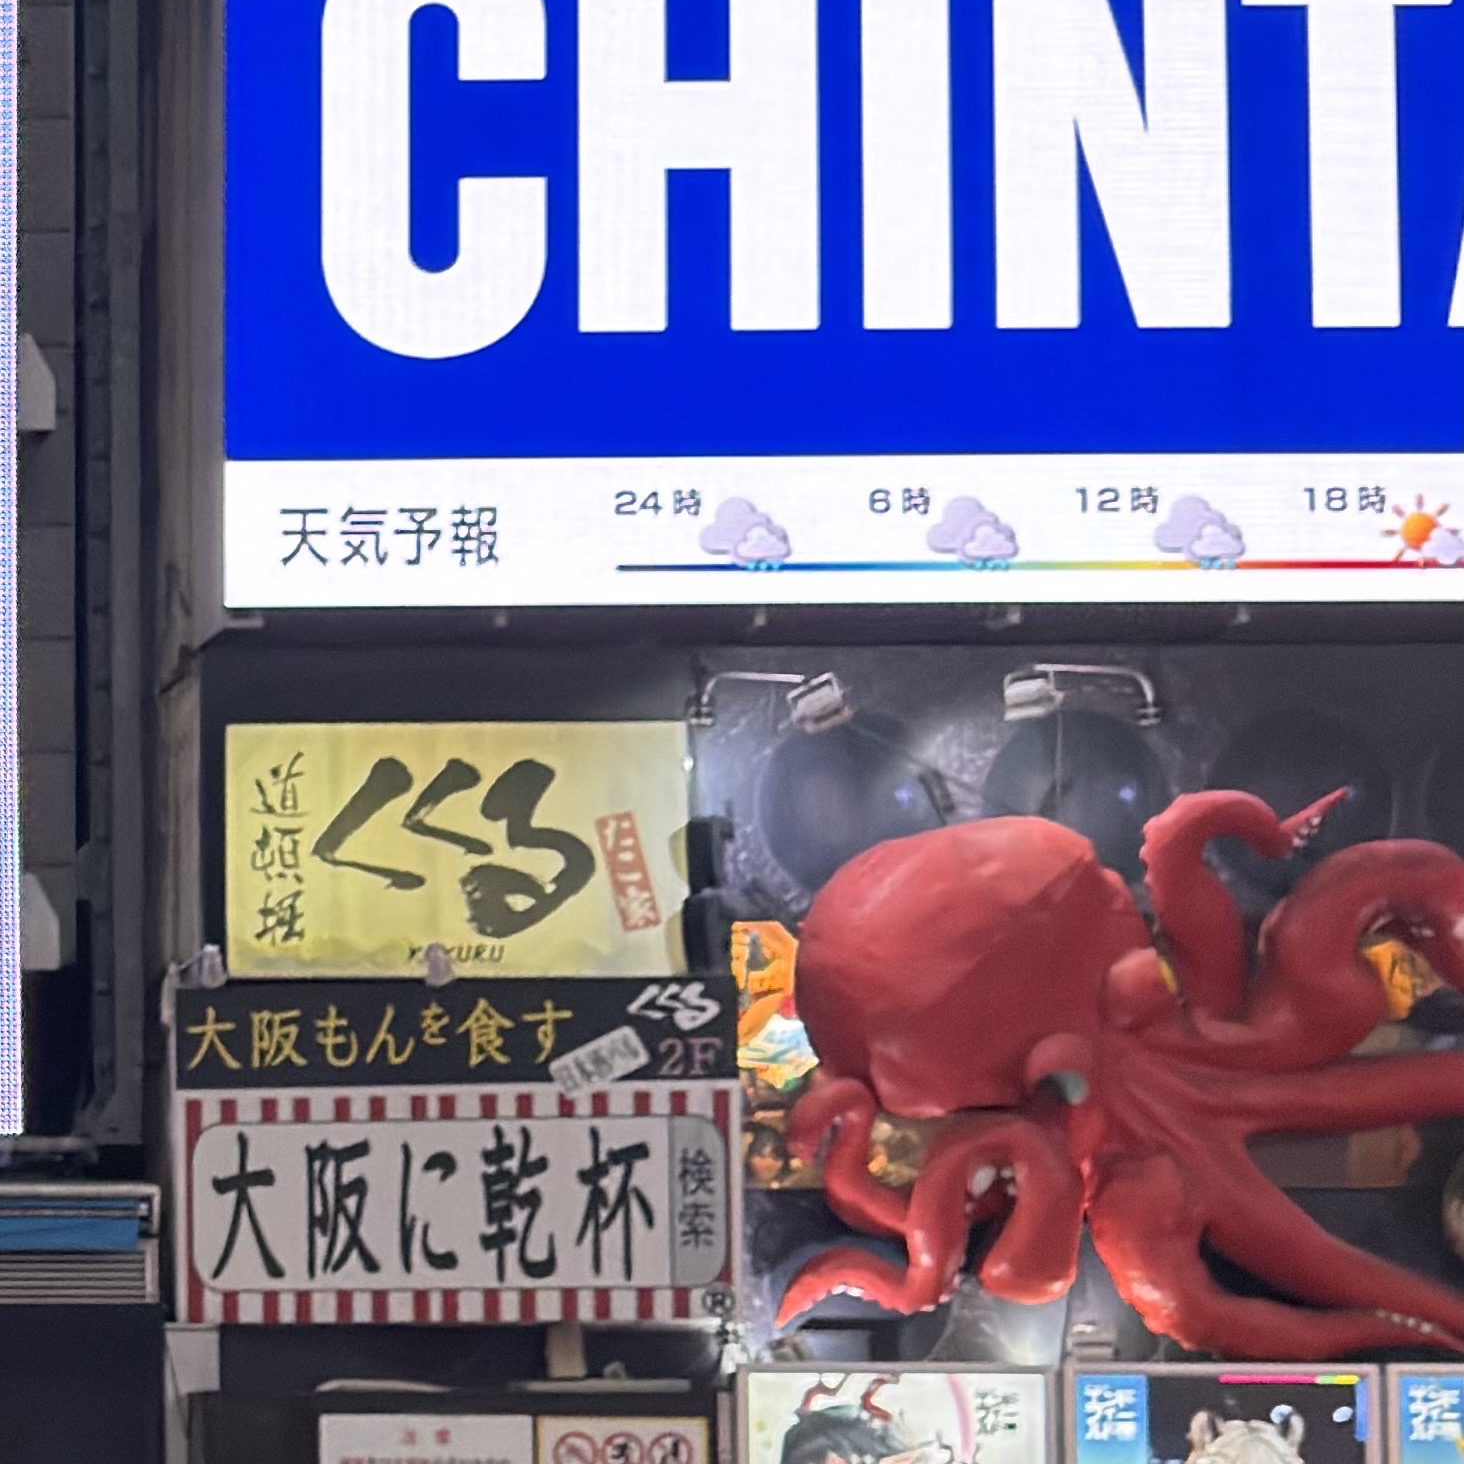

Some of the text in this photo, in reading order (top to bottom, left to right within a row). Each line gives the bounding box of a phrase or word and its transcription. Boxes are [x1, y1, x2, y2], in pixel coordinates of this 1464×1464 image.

[280, 508, 498, 566] 天気予報
[250, 752, 308, 945] 道頓堀
[310, 756, 595, 939] くくる
[187, 999, 574, 1071] 大阪もんを食す
[626, 982, 720, 1031] くくる
[659, 1038, 723, 1075] 2F
[212, 1125, 656, 1283] 大阪に乾杯
[678, 1147, 717, 1248] 検索
